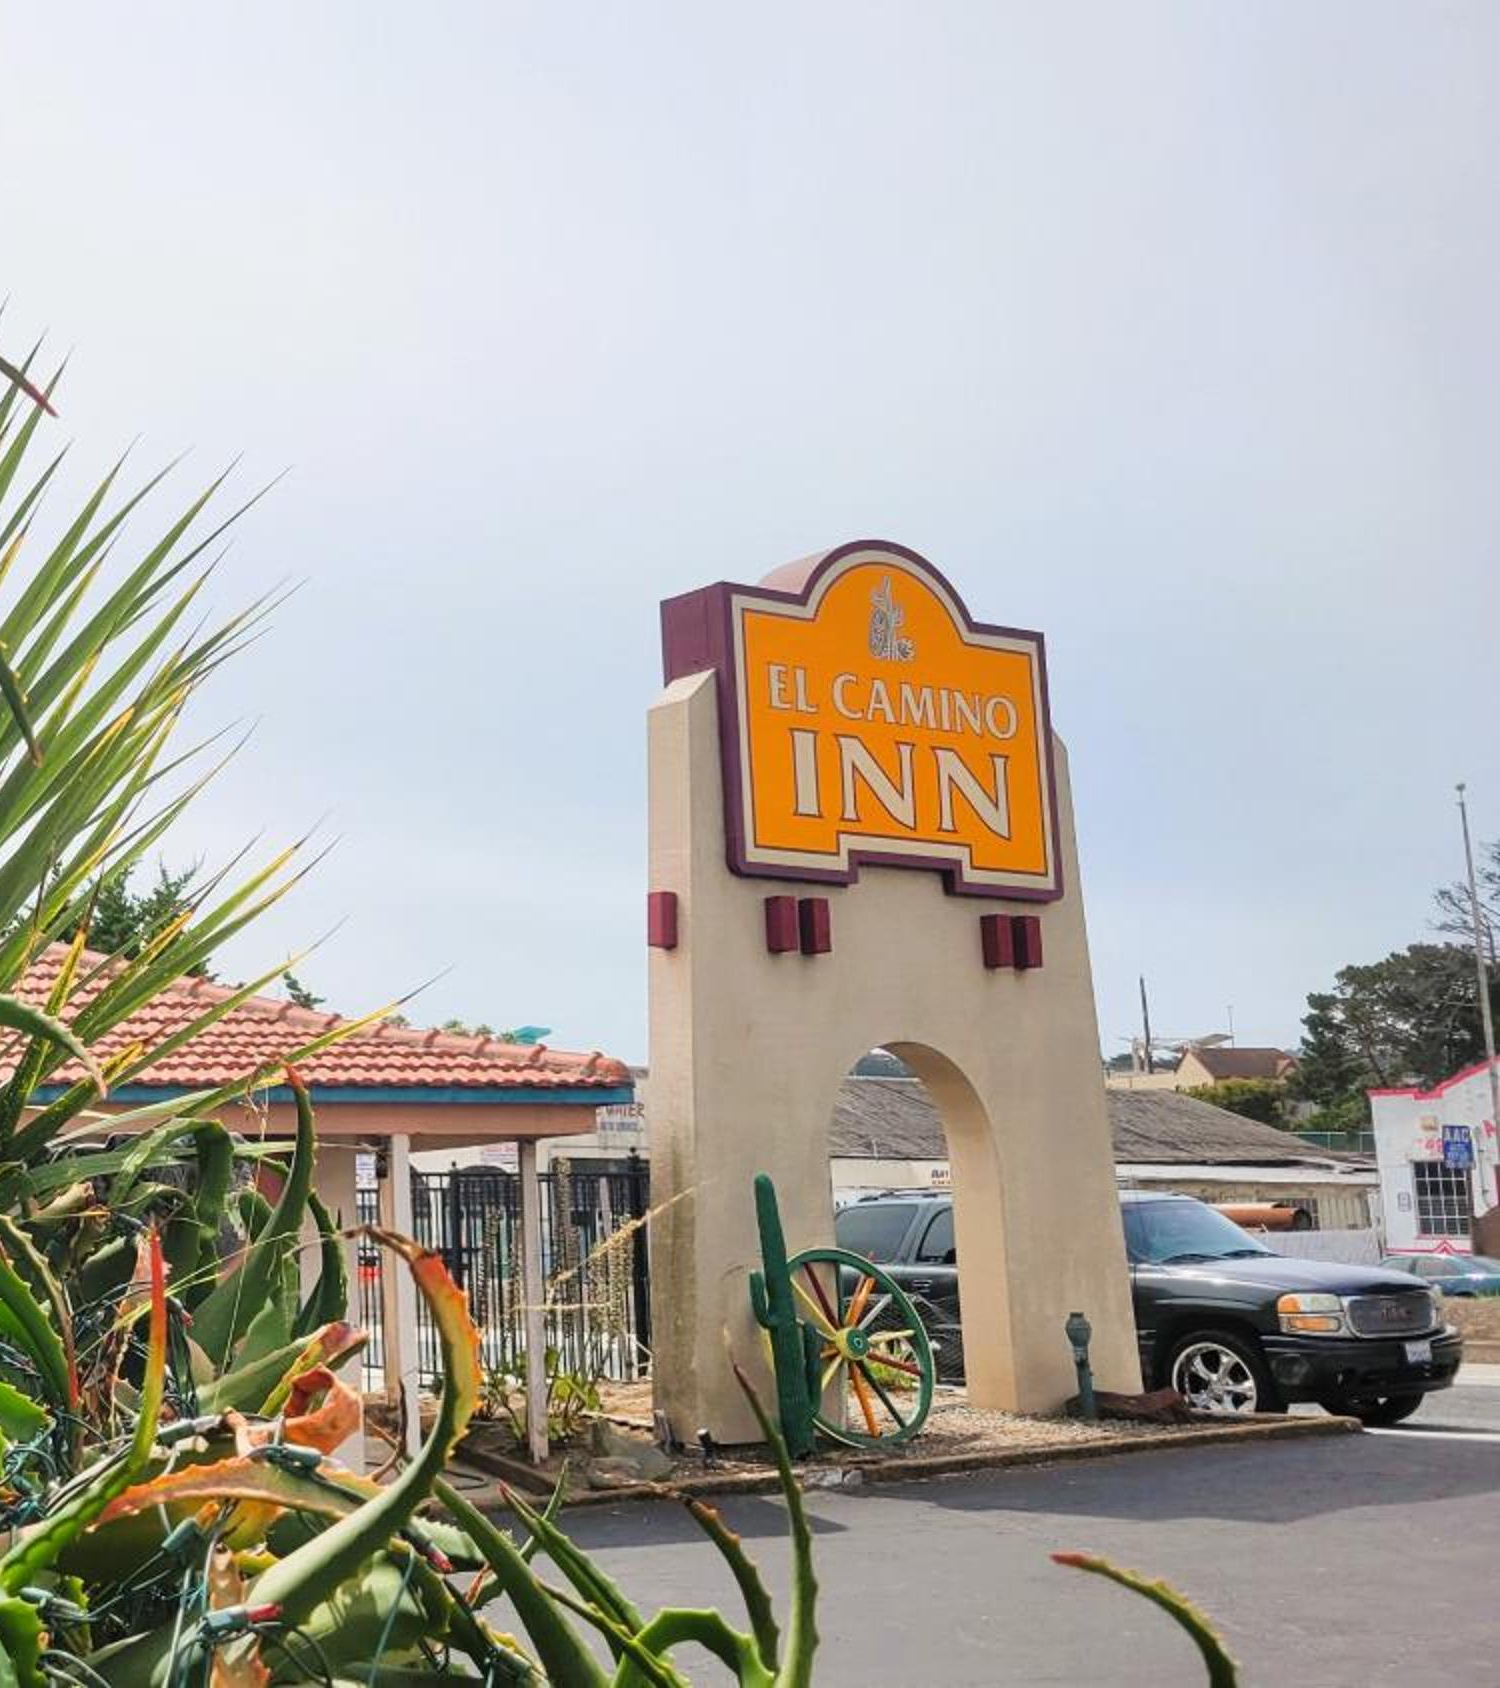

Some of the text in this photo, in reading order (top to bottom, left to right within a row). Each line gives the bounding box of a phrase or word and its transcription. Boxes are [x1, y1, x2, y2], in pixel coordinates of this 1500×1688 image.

[767, 662, 1018, 741] EL CAMINO
[789, 728, 1011, 840] INN
